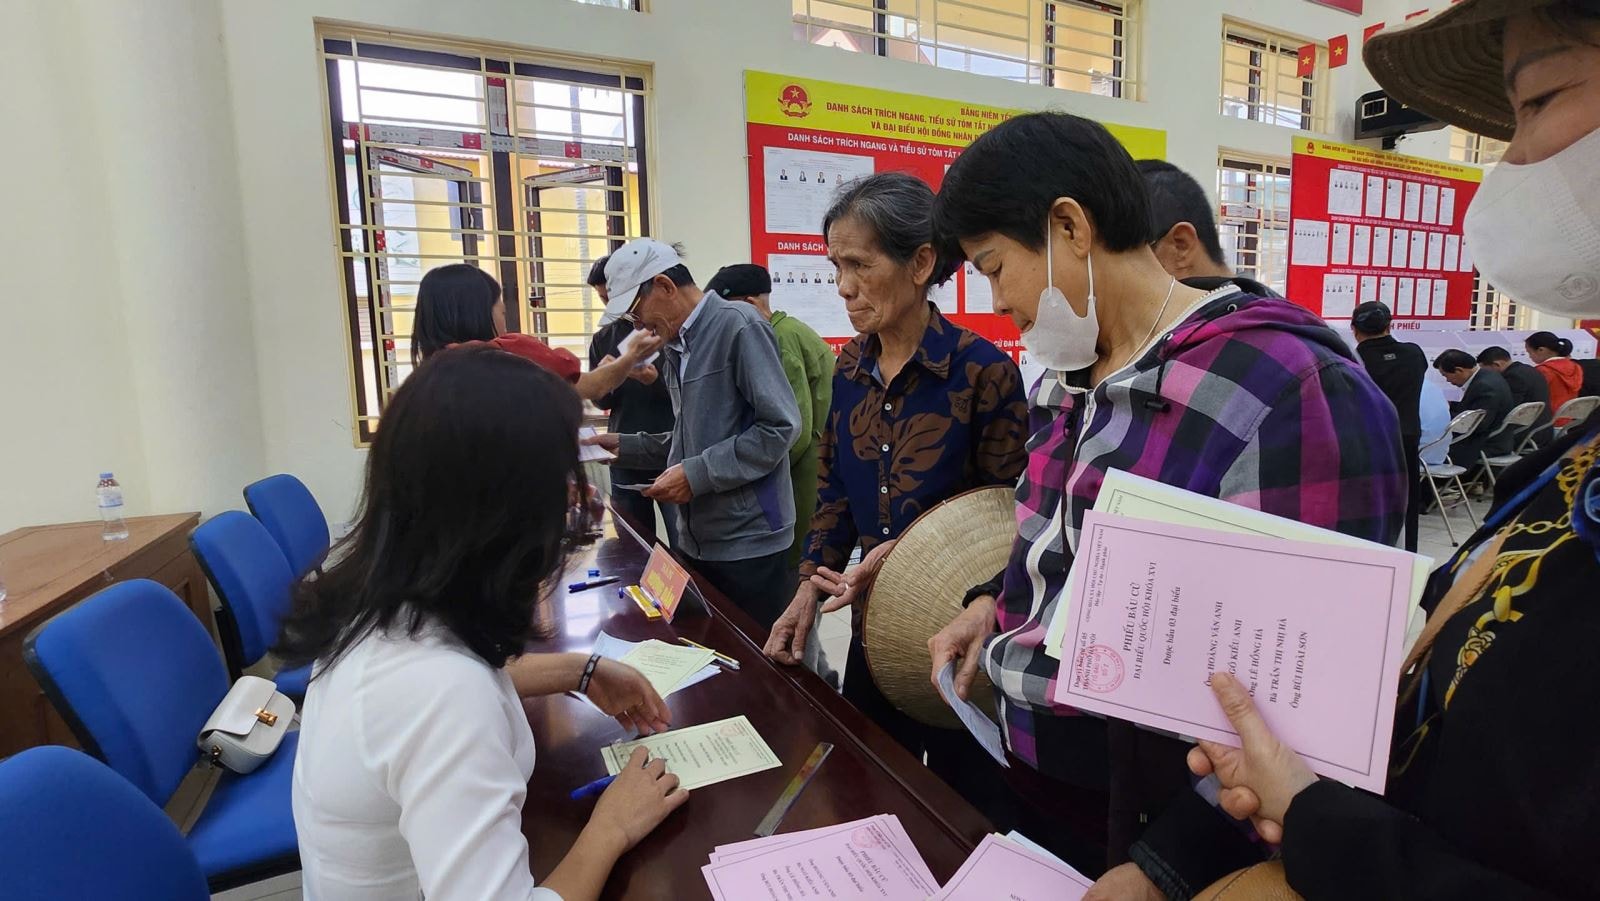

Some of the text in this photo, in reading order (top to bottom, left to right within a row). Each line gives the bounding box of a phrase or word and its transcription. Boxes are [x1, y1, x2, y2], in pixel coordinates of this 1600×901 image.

[826, 102, 849, 113] DANH
[851, 105, 873, 116] SÁCH
[874, 108, 897, 119] TRÍCH
[930, 114, 944, 125] TIỂU
[946, 116, 956, 126] SỬ
[958, 119, 972, 129] TÓM
[974, 121, 986, 130] TẮT
[961, 106, 980, 117] BẢNG
[982, 110, 999, 120] NIÊM
[871, 121, 881, 130] VÀ
[883, 123, 896, 134] ĐẠI
[898, 122, 916, 134] BIỂU
[918, 127, 930, 137] HỘI
[932, 128, 952, 138] ĐỒNG
[953, 131, 972, 141] NHÂN
[788, 132, 956, 159] DANH SÁCH TRÍCH NGANG VÀ TIỂU SỬ TÓM TẮT
[778, 242, 800, 250] DANH
[802, 241, 824, 252] SÁCH
[1397, 321, 1420, 330] PHIẾU
[1148, 562, 1157, 576] XVI
[1144, 578, 1154, 601] KHÓA
[1171, 586, 1182, 602] biểu
[1122, 582, 1140, 652] PHIẾU BẦU CỬ
[1142, 602, 1152, 618] HỘI
[1214, 600, 1224, 620] ANH
[1137, 618, 1149, 642] QUỐC
[1168, 618, 1176, 627] 03
[1210, 622, 1220, 638] VĂN
[1276, 618, 1288, 631] HÀ
[1166, 628, 1176, 644] bầu
[1253, 628, 1264, 640] HÀ
[1134, 642, 1145, 664] BIỂU
[1206, 640, 1218, 670] HOÀNG
[1227, 620, 1243, 678] GÔ KIỀU ANH
[1249, 642, 1262, 668] HỒNG
[1274, 650, 1284, 665] THỊ
[1248, 668, 1258, 680] LÊ
[1288, 630, 1308, 709] Ông BÙI HOÀI SƠN
[1268, 666, 1280, 690] TRẦN
[1269, 692, 1278, 703] Bà
